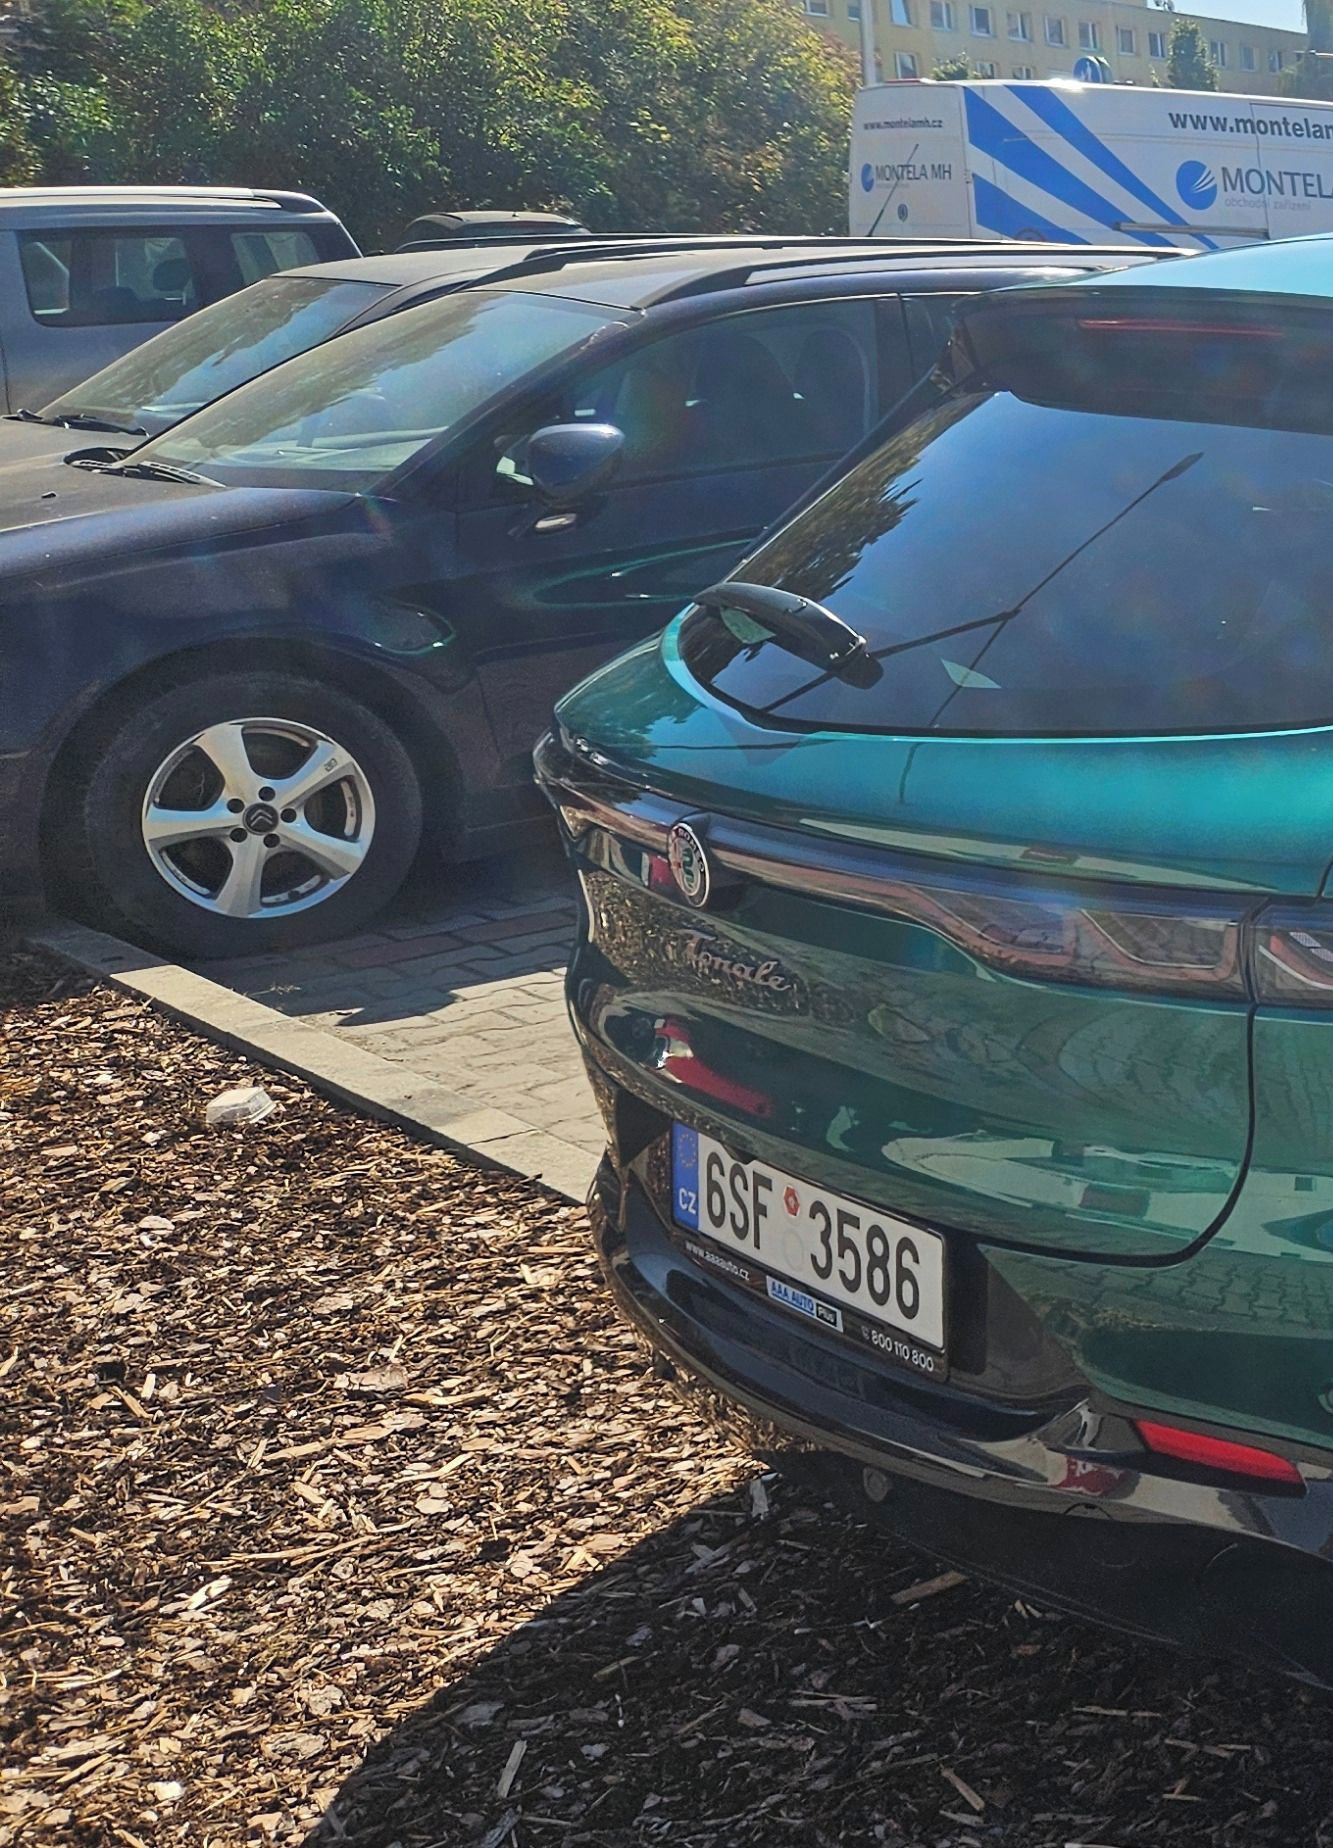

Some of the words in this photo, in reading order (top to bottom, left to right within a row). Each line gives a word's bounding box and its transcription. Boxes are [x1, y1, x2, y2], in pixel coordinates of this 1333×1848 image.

[876, 164, 928, 181] MONTELA
[931, 163, 952, 180] MH
[675, 928, 792, 992] Tonale
[678, 1187, 697, 1216] CZ
[706, 1151, 773, 1250] 6SF
[808, 1200, 920, 1320] 3586
[772, 1281, 789, 1300] AAA
[791, 1290, 814, 1311] AUTO
[871, 1329, 893, 1352] 800
[894, 1341, 910, 1361] 110
[911, 1349, 934, 1372] 800
